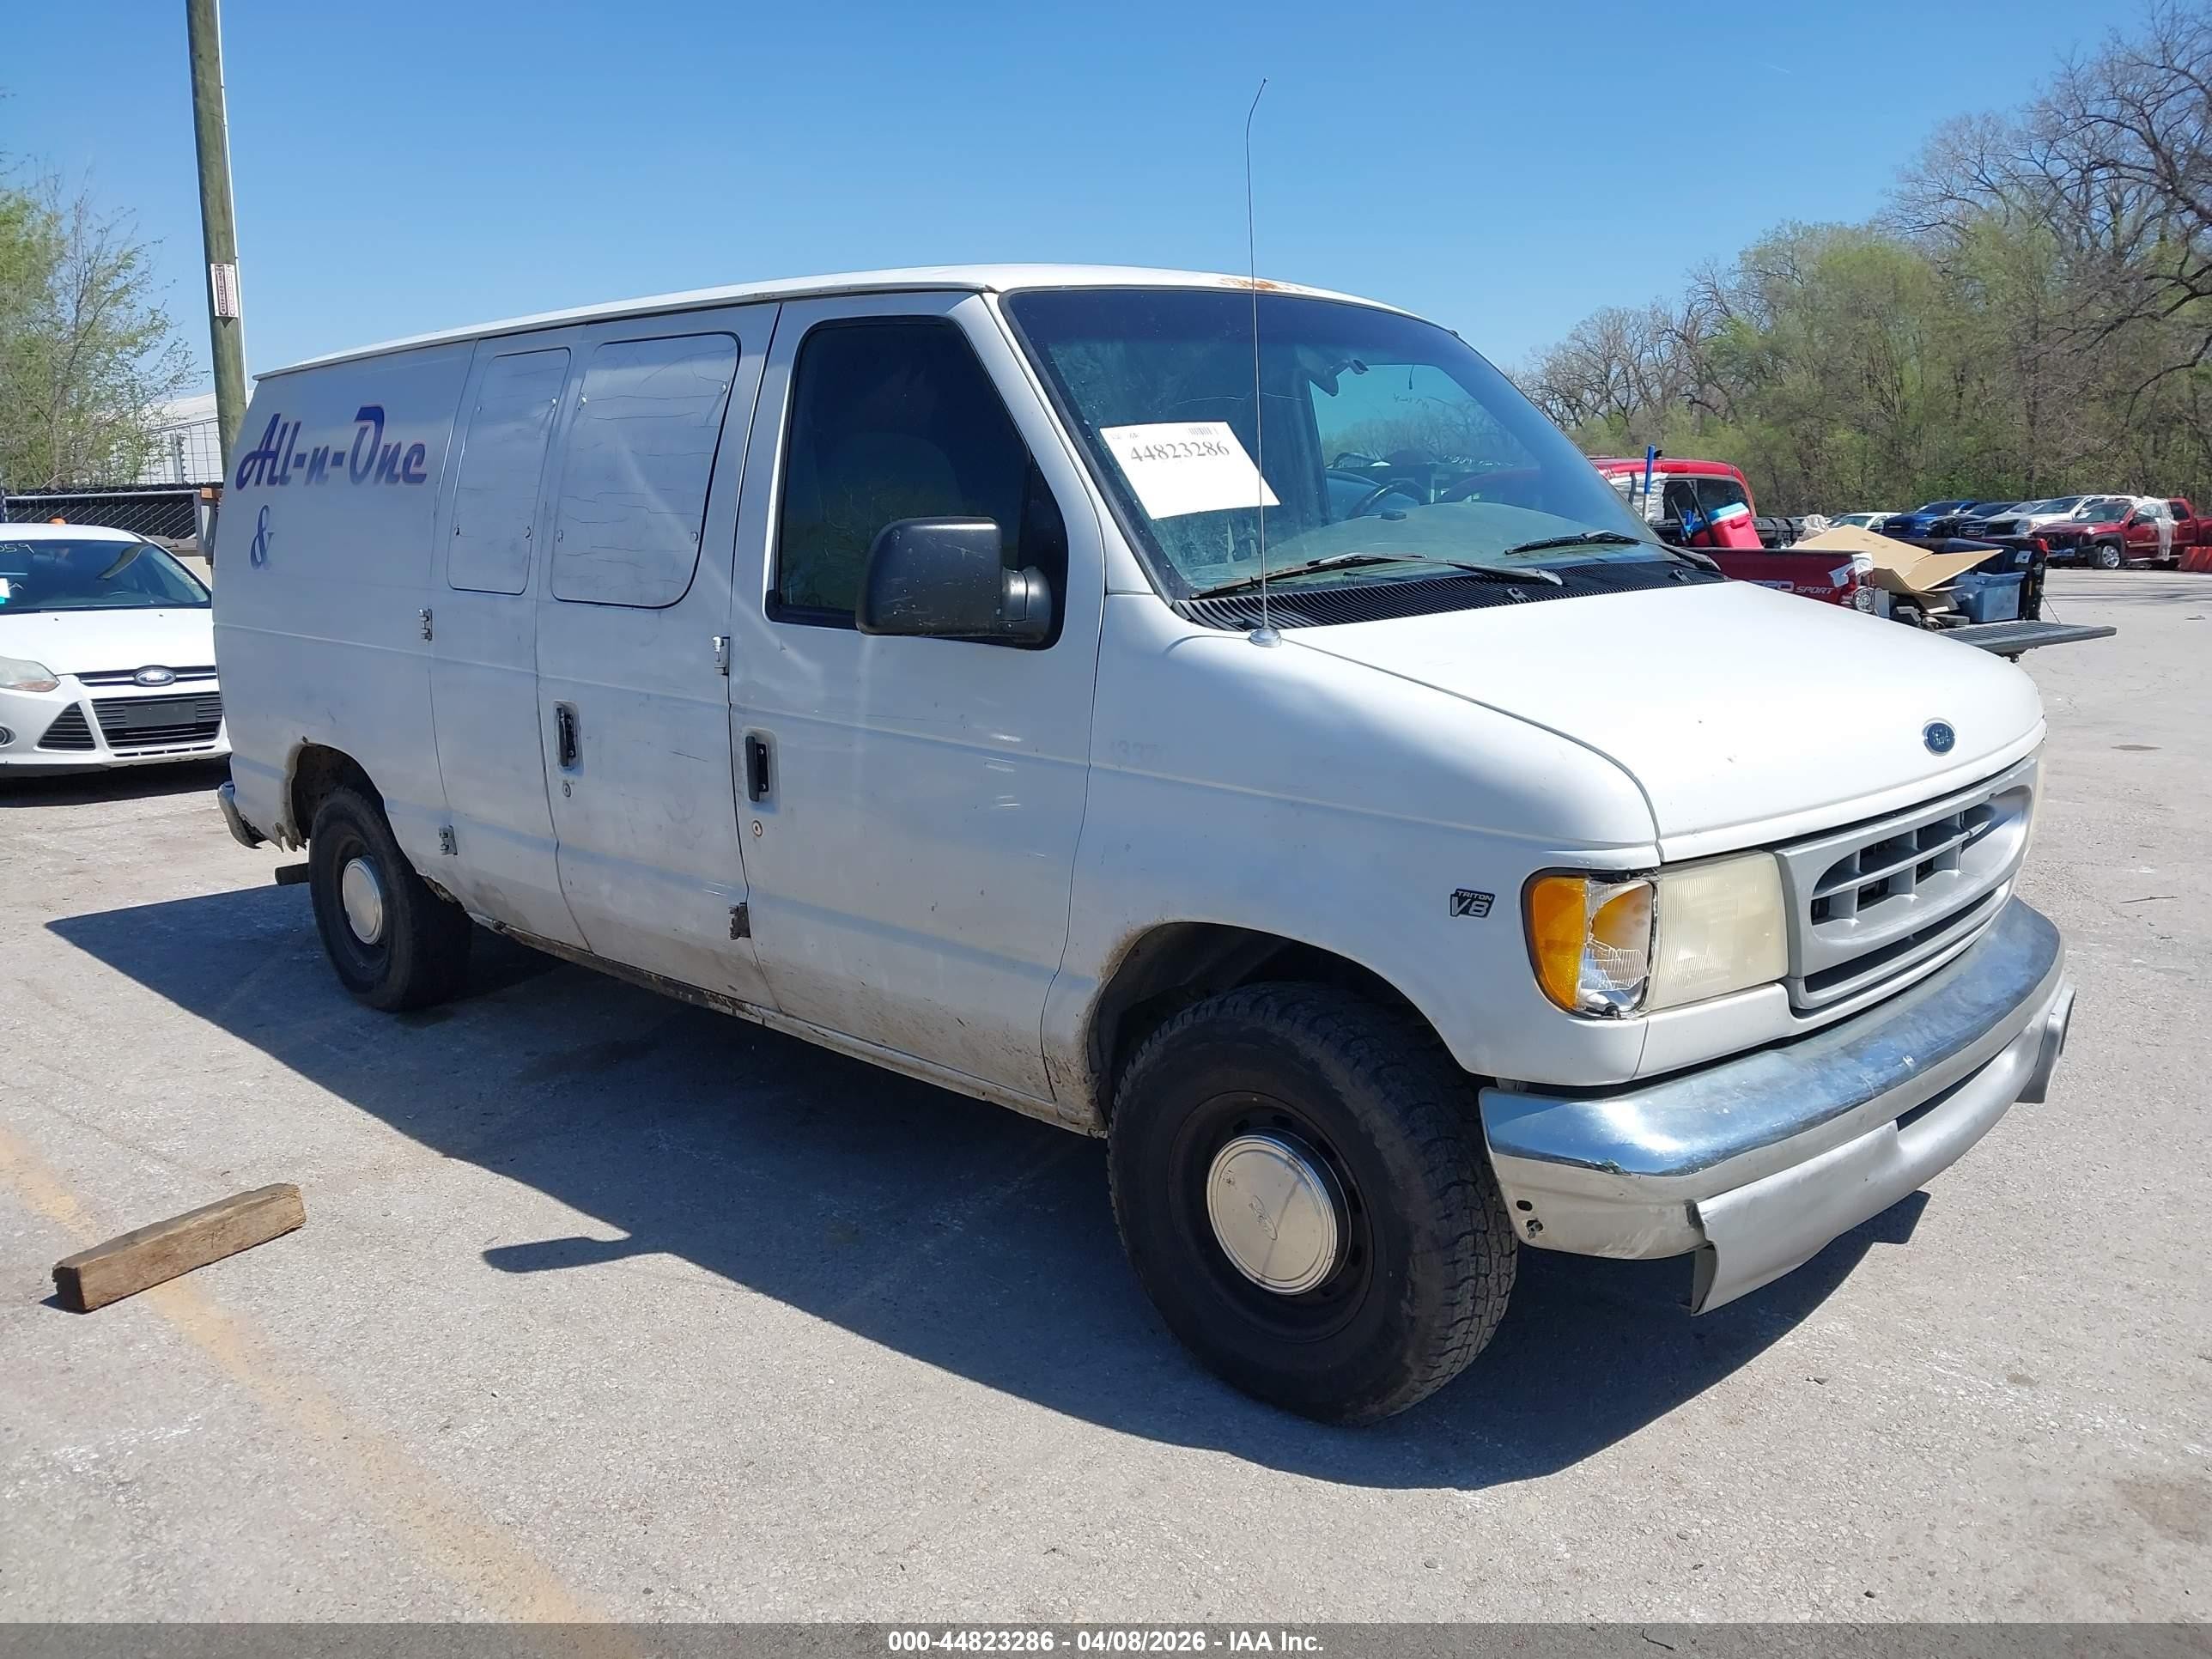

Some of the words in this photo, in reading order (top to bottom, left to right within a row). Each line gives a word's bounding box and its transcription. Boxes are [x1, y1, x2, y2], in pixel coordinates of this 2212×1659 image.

[235, 405, 427, 490] All-n-One
[1131, 441, 1230, 462] 44823286
[1796, 586, 1834, 594] SPORT
[1452, 896, 1489, 916] V8
[1457, 890, 1493, 902] TRITON
